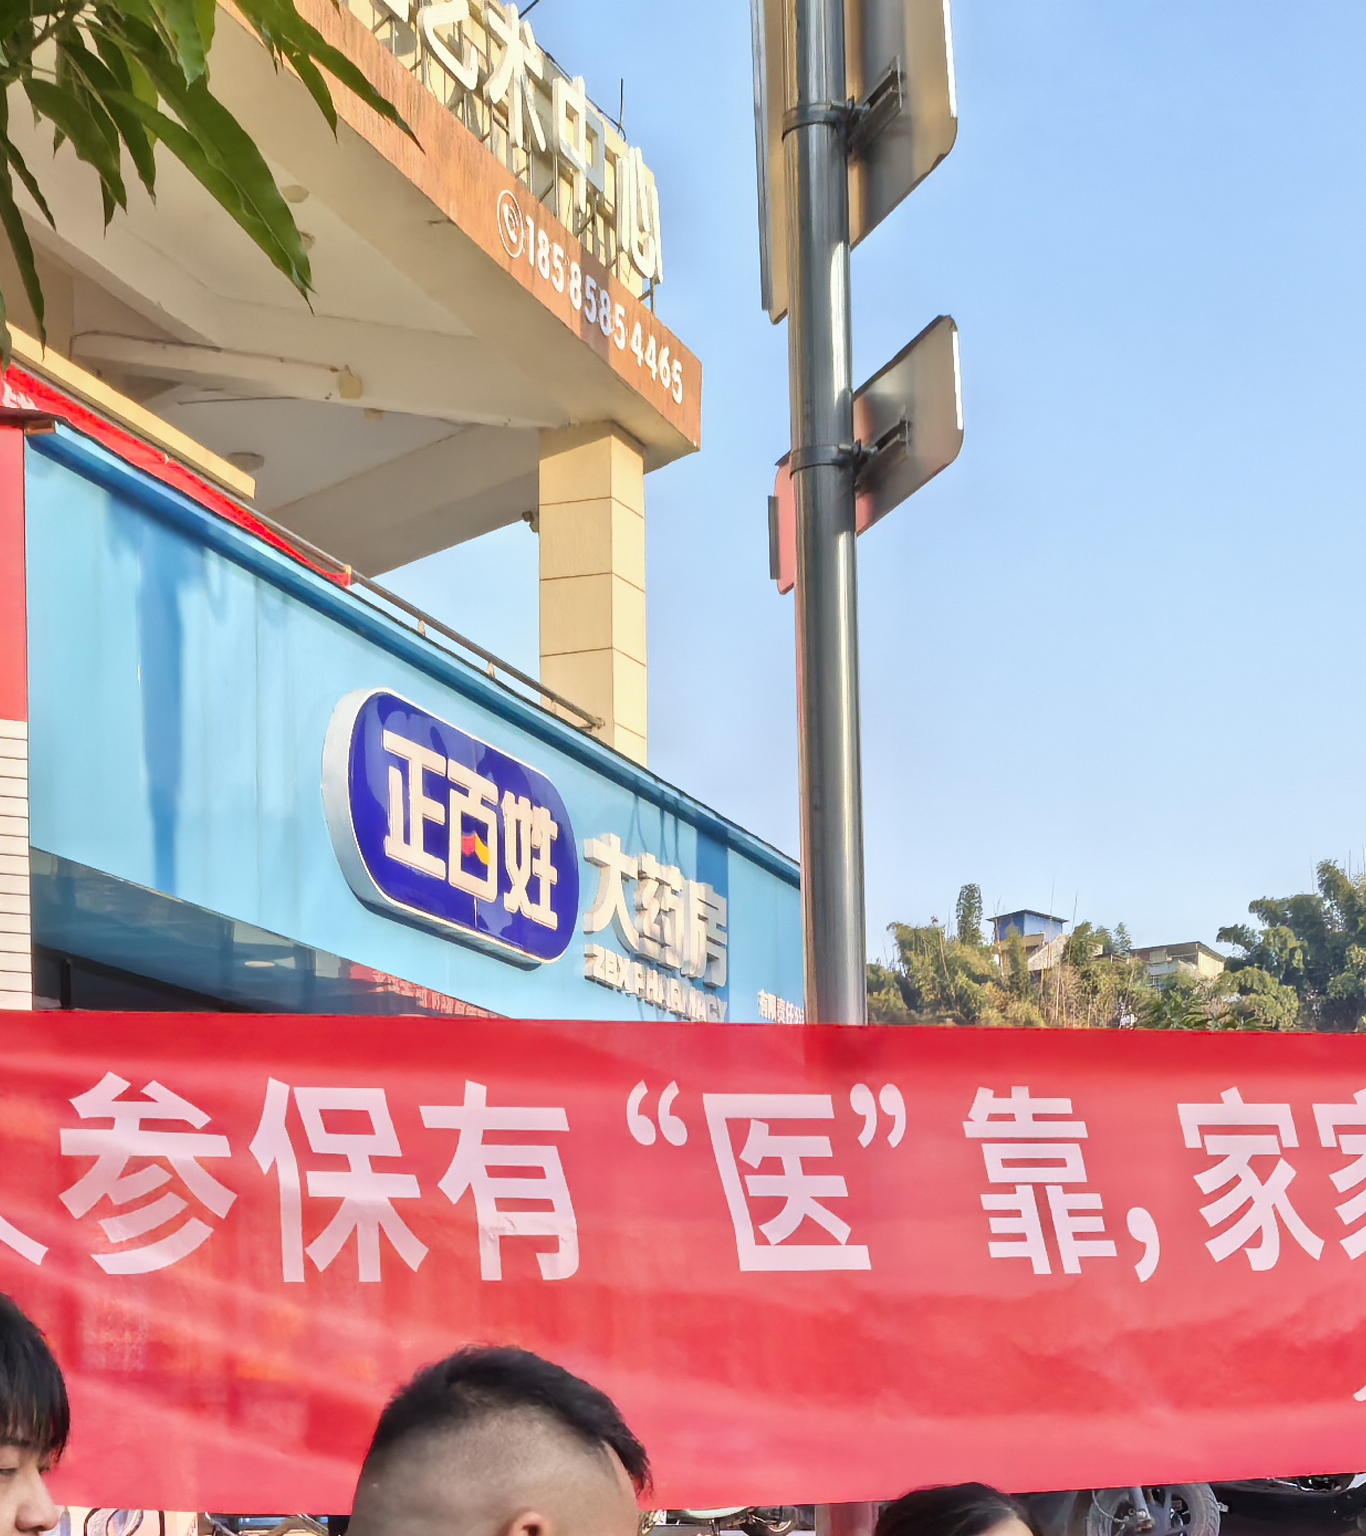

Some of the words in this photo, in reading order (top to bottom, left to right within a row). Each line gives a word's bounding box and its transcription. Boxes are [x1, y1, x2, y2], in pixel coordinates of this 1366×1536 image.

[370, 0, 663, 284] 艺术中心
[525, 215, 683, 405] 18585854465
[381, 729, 558, 932] 正百姓
[583, 833, 728, 988] 大药房
[631, 960, 727, 1023] PHARMACY
